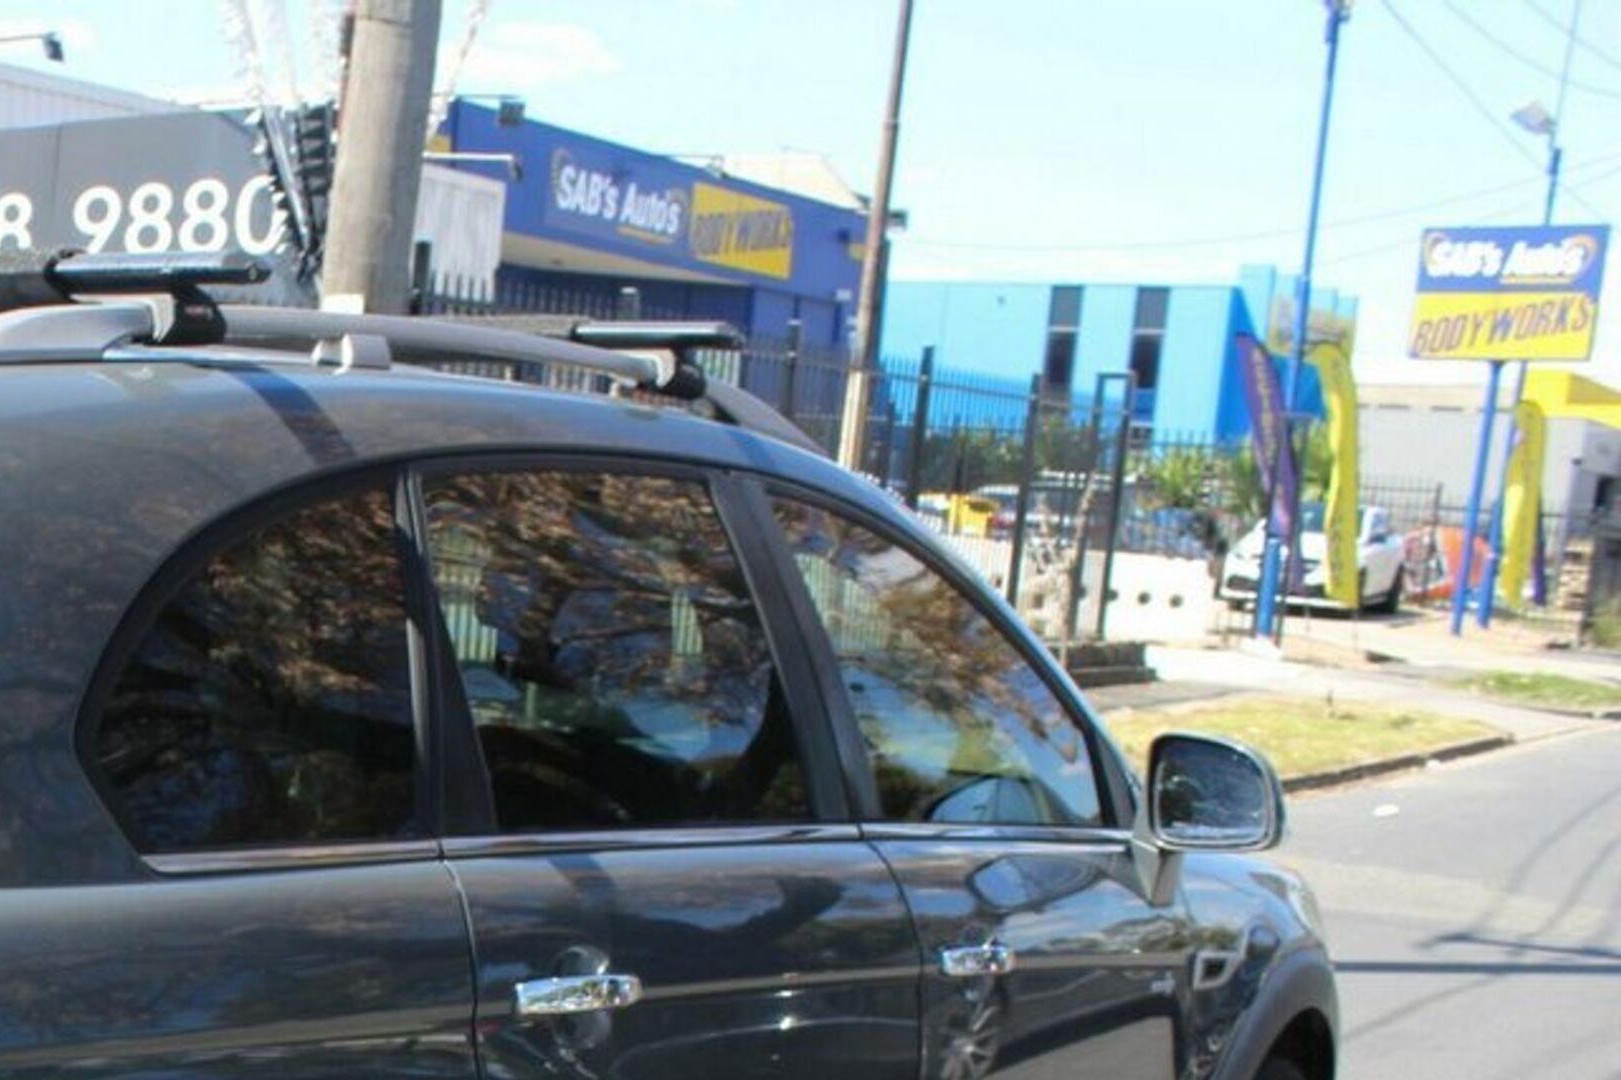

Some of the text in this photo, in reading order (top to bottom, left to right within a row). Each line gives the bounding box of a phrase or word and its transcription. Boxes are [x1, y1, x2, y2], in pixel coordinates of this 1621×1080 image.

[72, 174, 287, 256] 9880
[556, 165, 681, 235] SAB's Auto's
[1412, 294, 1590, 354] BODYWORKS
